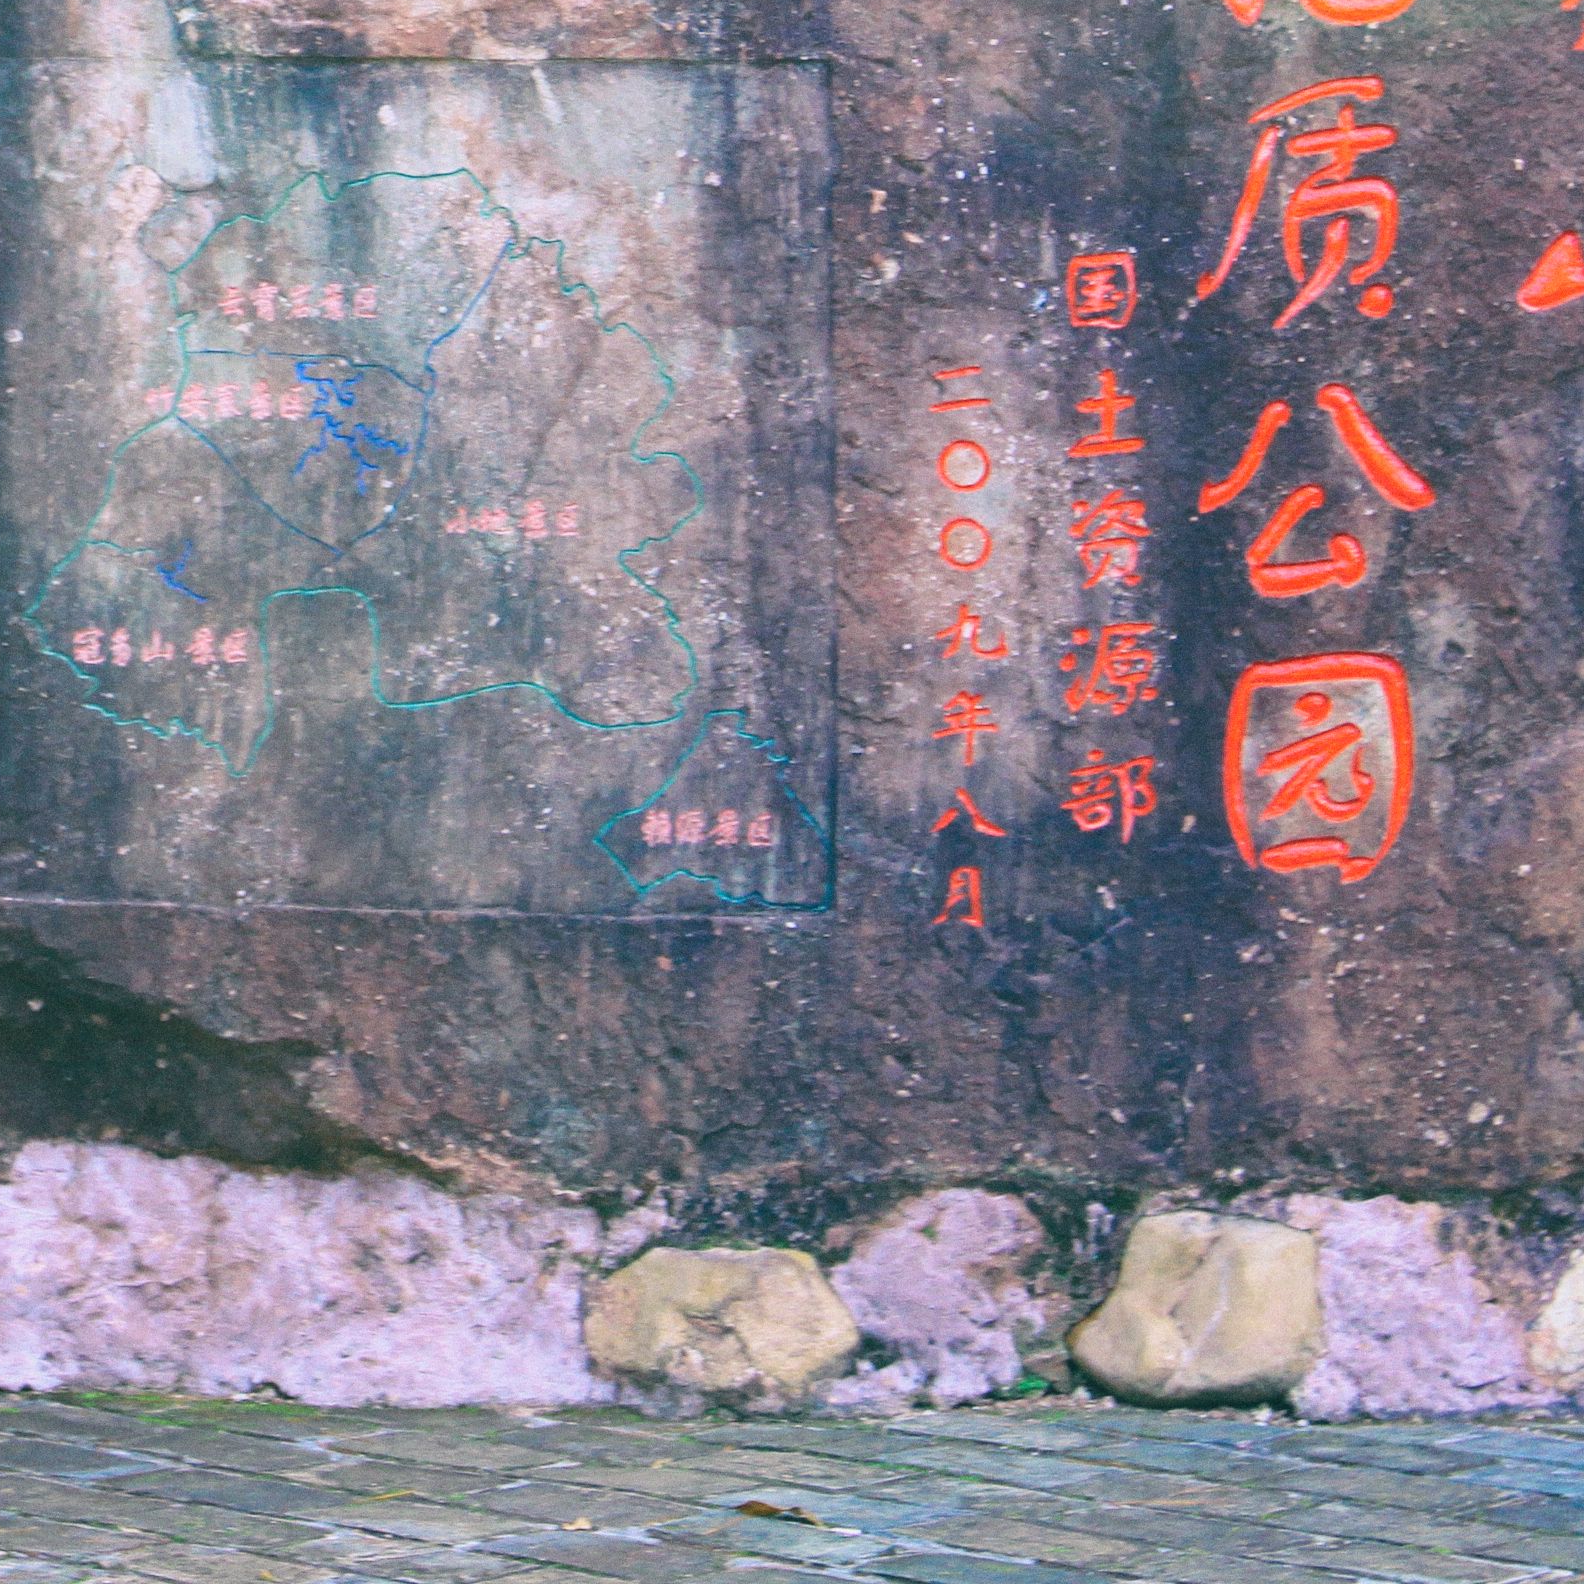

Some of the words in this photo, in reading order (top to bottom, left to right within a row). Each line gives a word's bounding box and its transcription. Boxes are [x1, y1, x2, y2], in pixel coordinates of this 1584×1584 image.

[1059, 252, 1158, 844] 国土资源部
